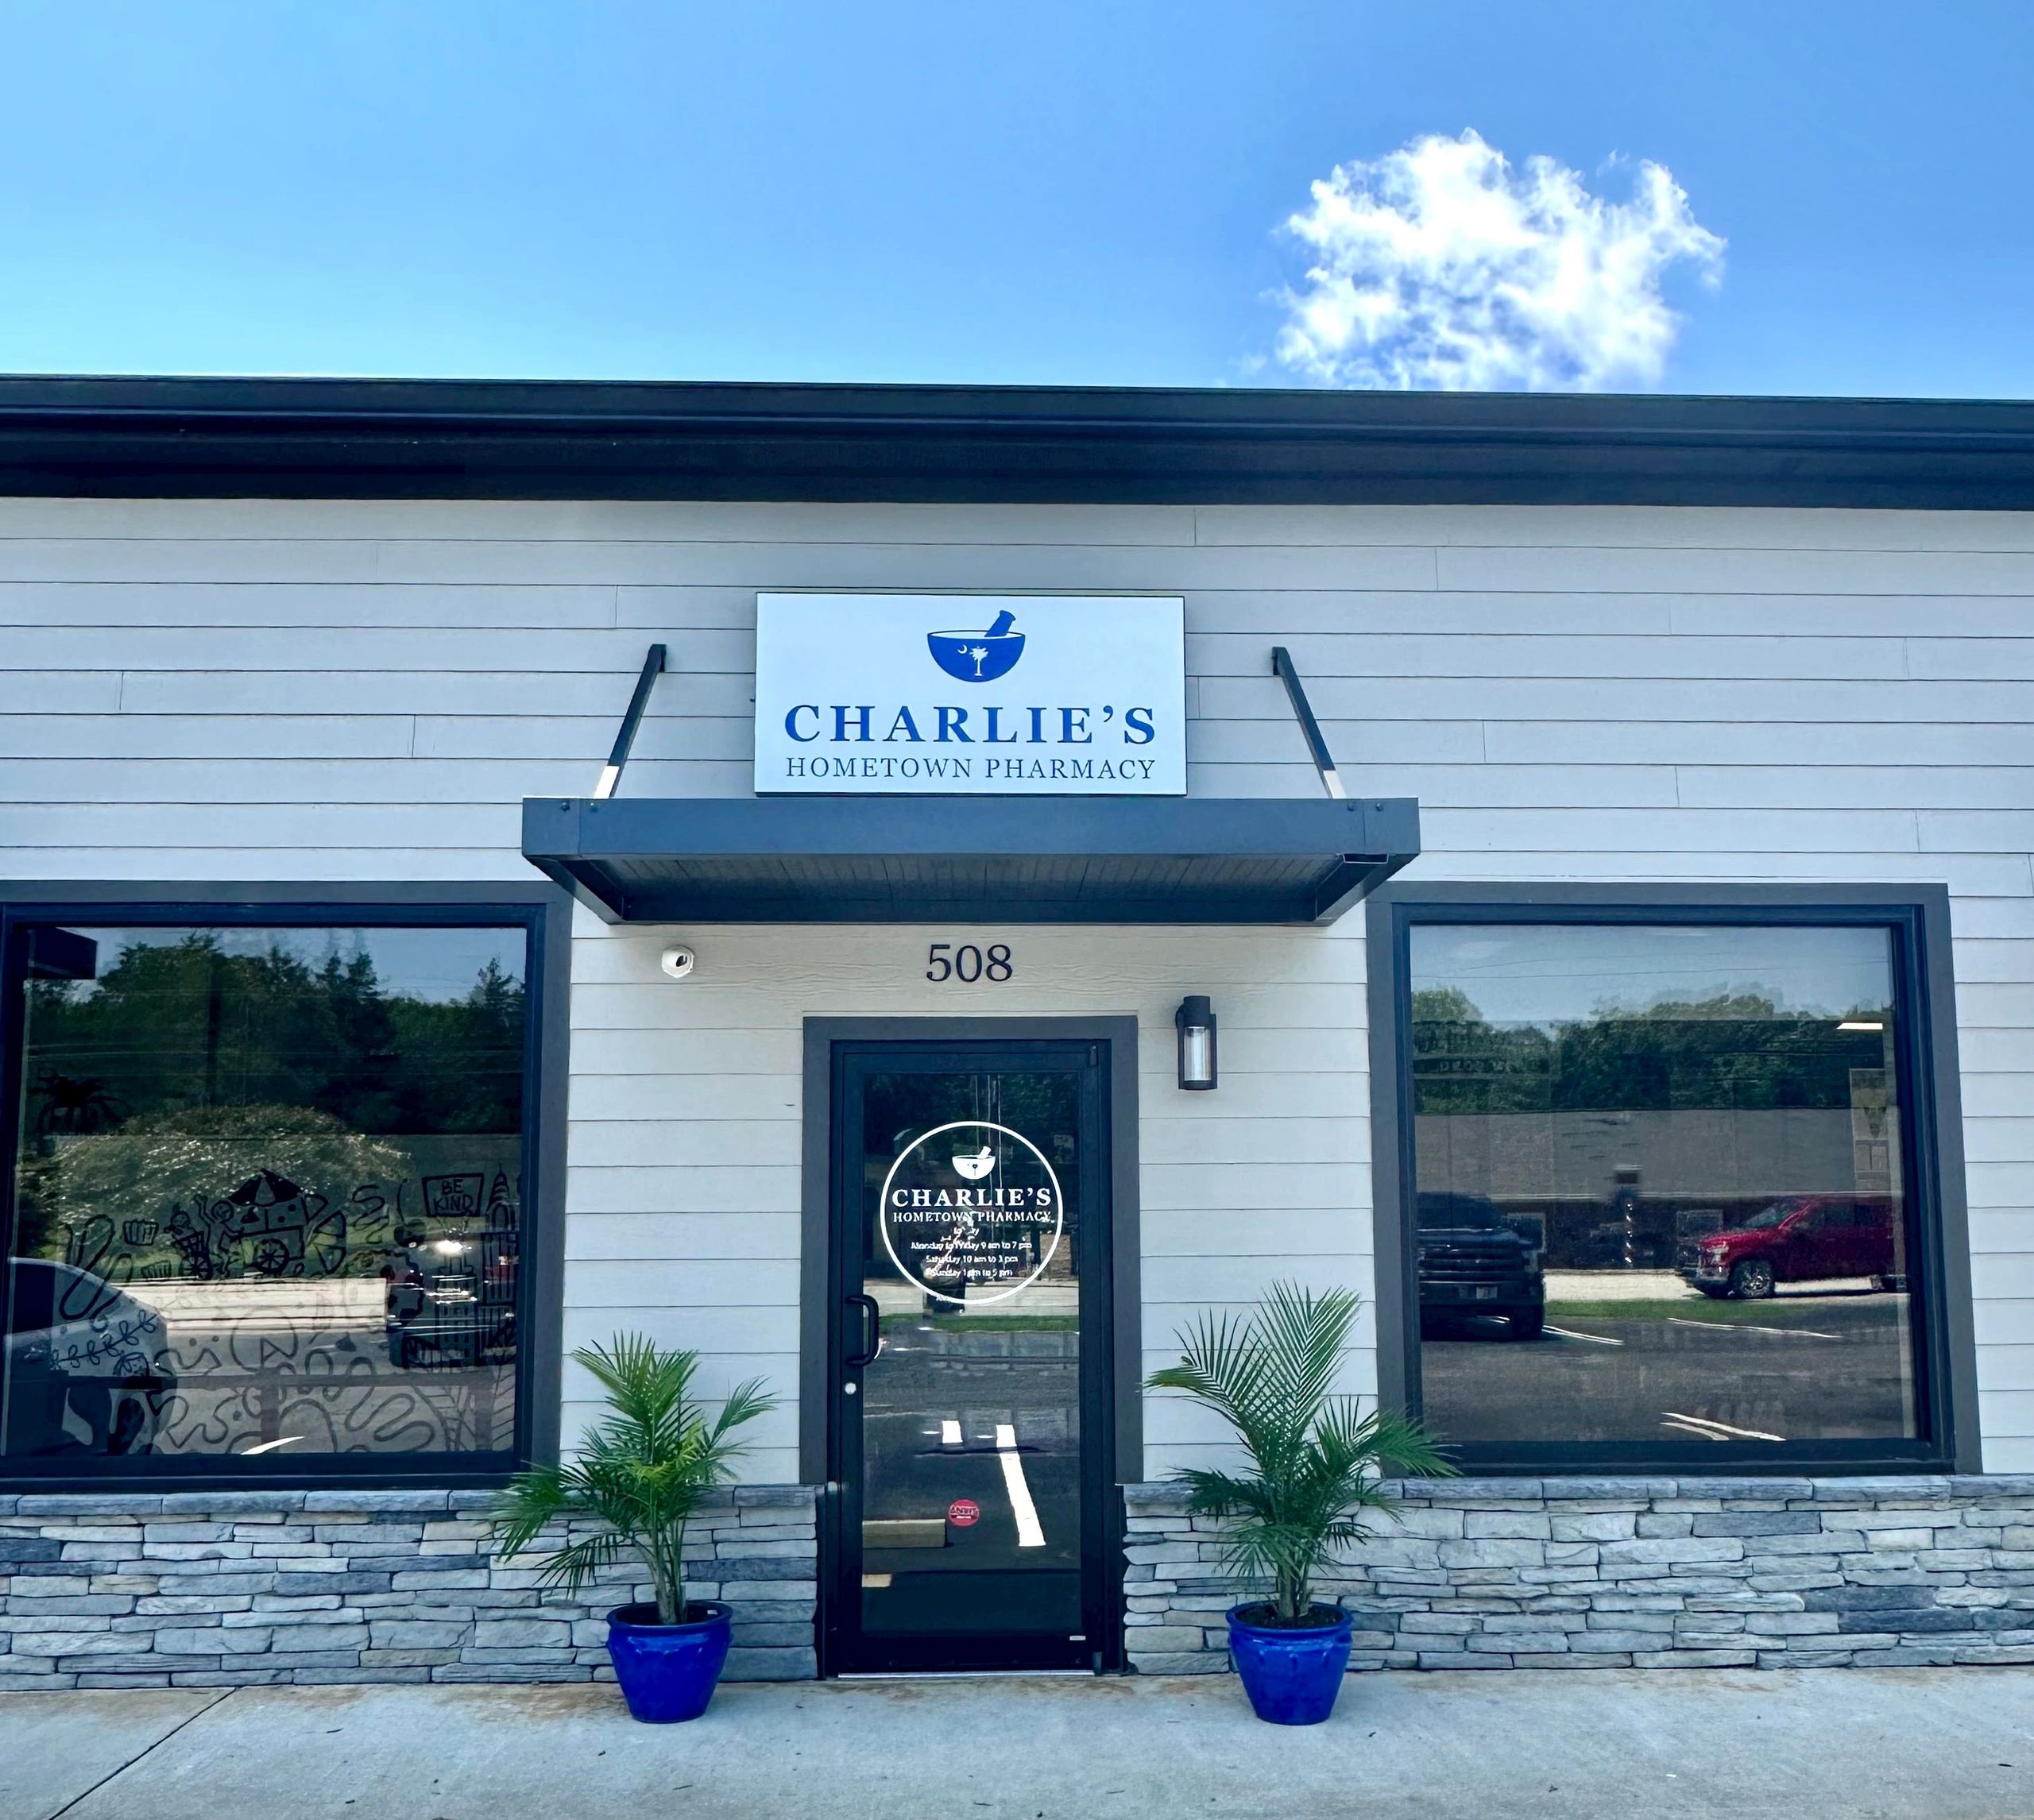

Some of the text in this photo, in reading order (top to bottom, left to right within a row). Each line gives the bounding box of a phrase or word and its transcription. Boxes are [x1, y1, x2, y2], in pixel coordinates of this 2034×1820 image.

[784, 704, 1155, 745] CHARLIE’S
[786, 756, 1156, 779] HOMETOWN PHARMACY
[926, 944, 1013, 983] 508
[442, 1179, 464, 1195] BE
[433, 1194, 474, 1212] KIND
[891, 1188, 1052, 1207] CHARLIE’S
[893, 1211, 1053, 1223] HOMETOWN PHARMACY
[911, 1242, 944, 1251] Monday
